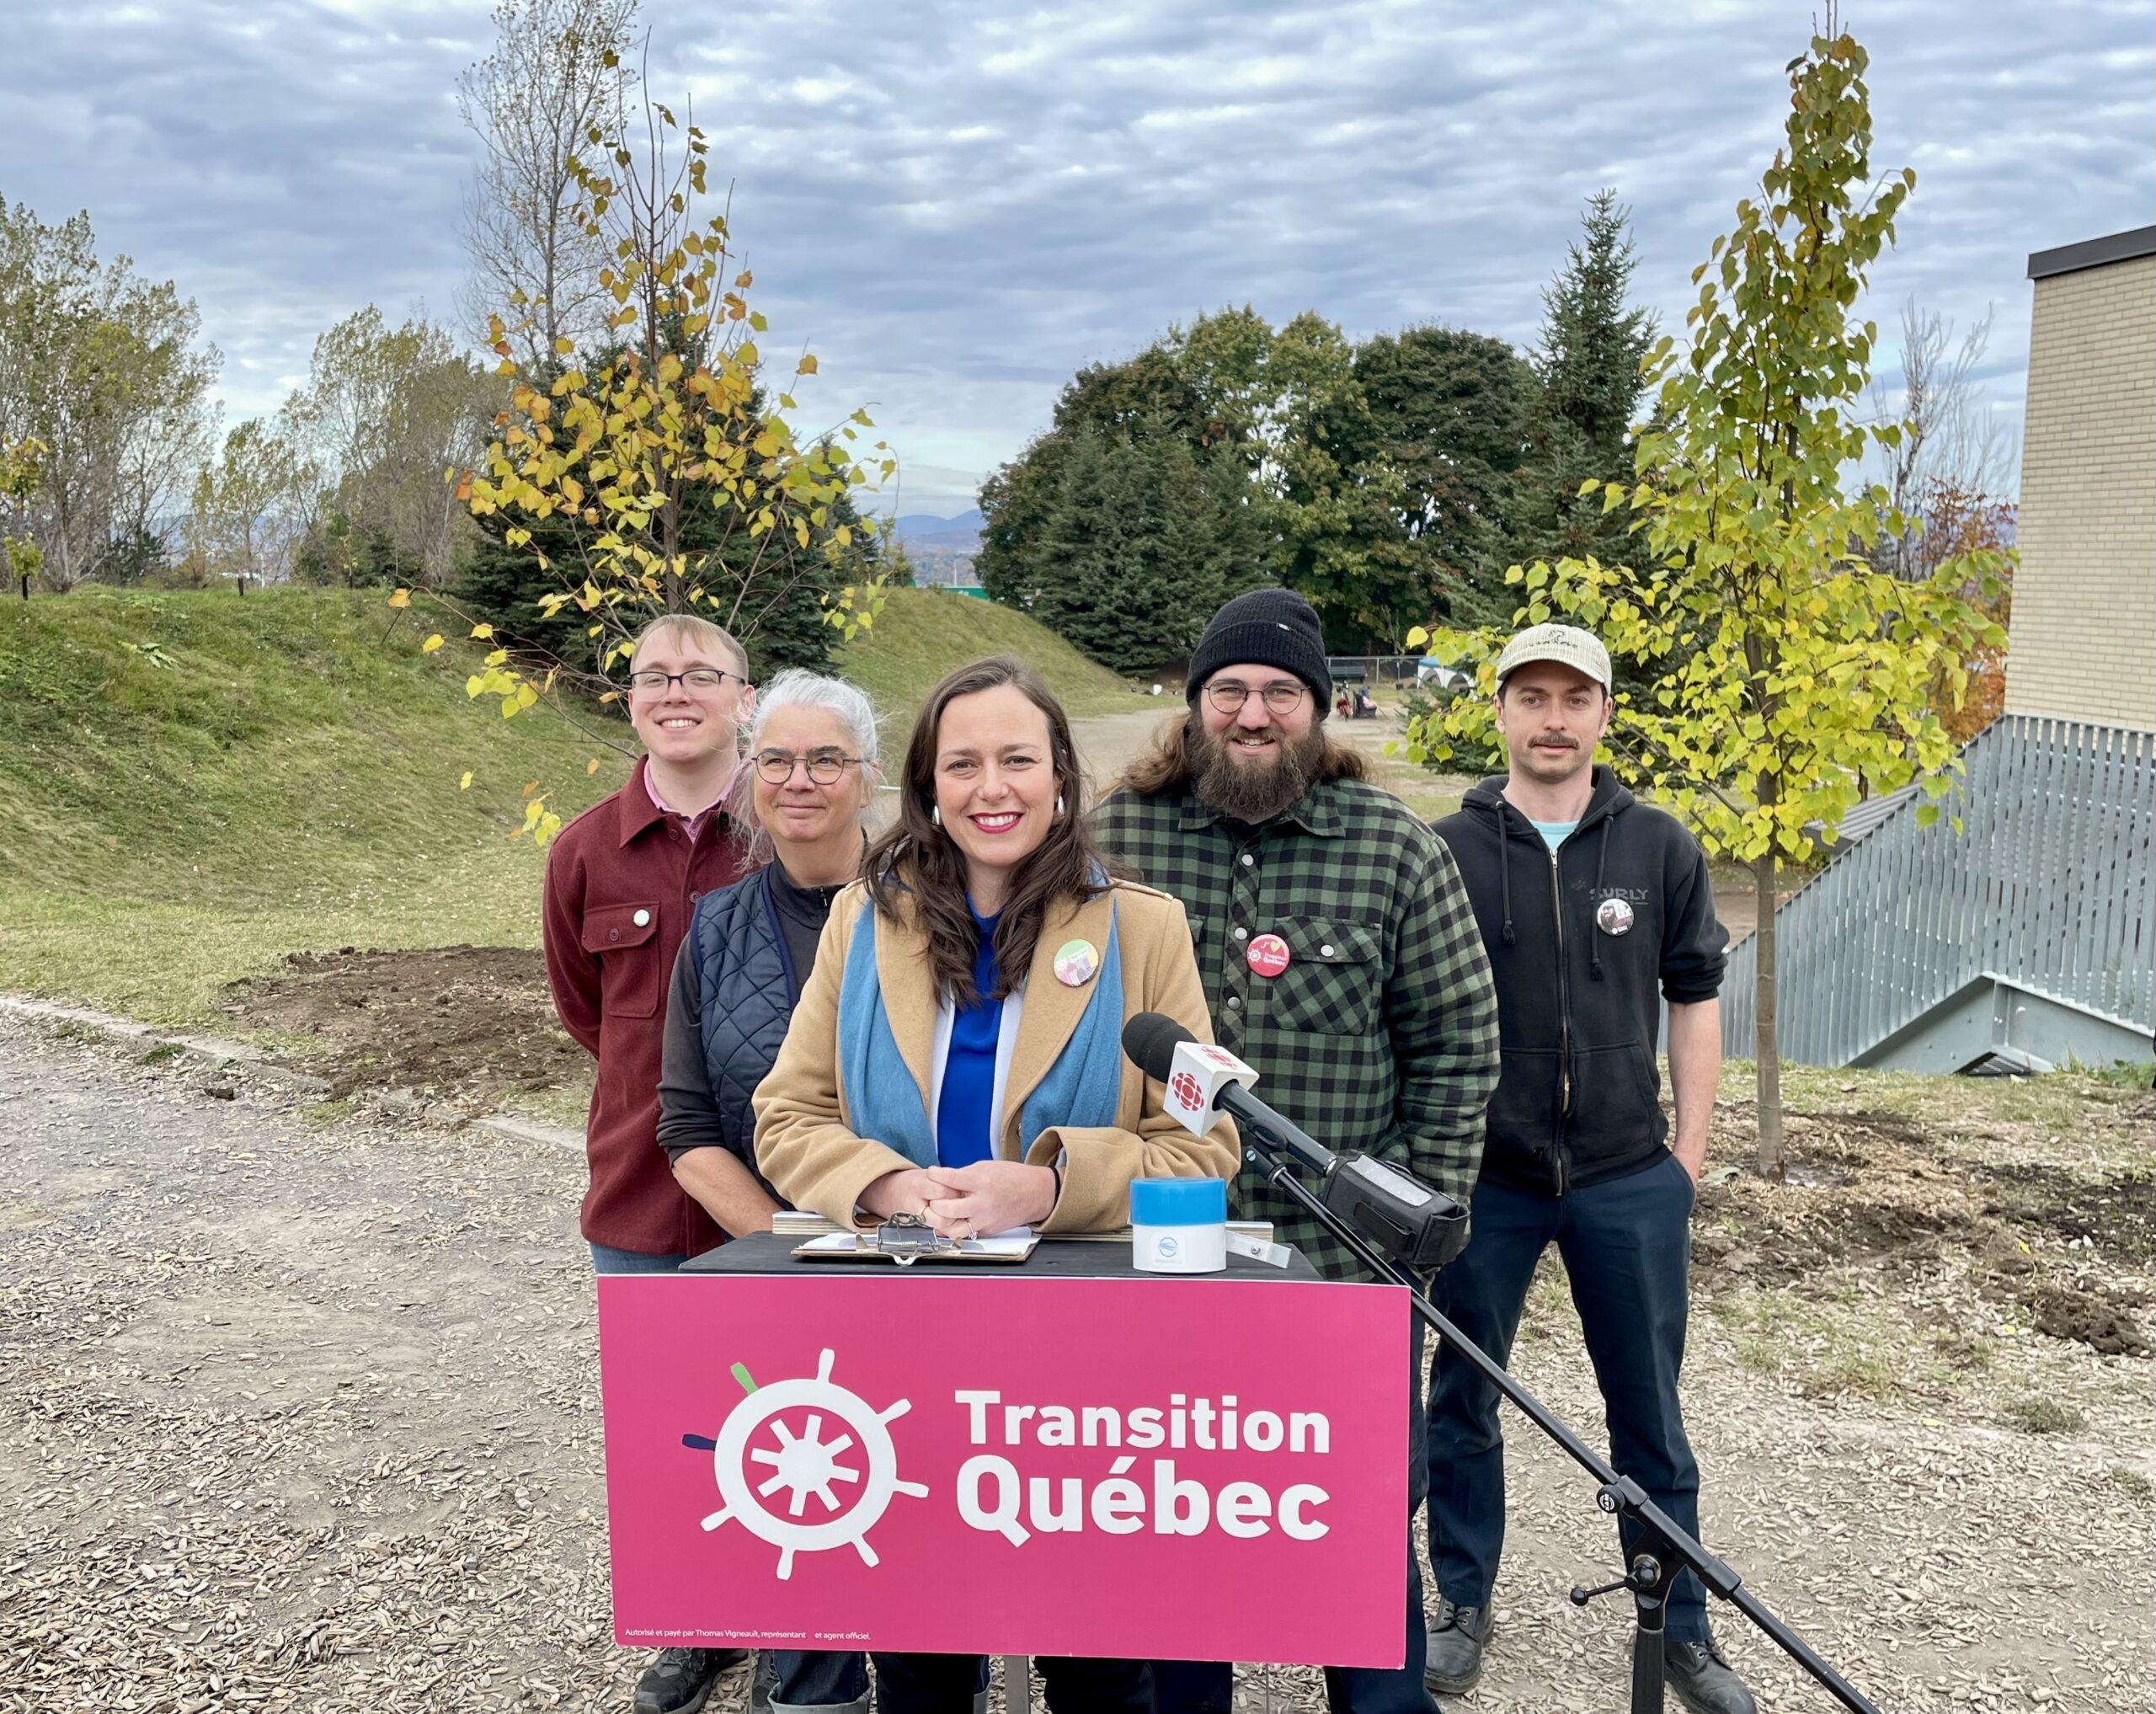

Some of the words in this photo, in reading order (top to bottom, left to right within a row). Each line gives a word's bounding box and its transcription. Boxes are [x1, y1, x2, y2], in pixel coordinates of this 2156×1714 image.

[954, 1390, 1331, 1454] Transition
[956, 1454, 1331, 1548] Québec
[625, 1628, 654, 1637] Autorisé
[664, 1629, 682, 1638] payé
[696, 1629, 724, 1637] Thomas
[724, 1630, 760, 1639] Vigneault,
[760, 1631, 806, 1639] représentant
[823, 1632, 845, 1641] agent
[845, 1631, 872, 1641] officiel.
